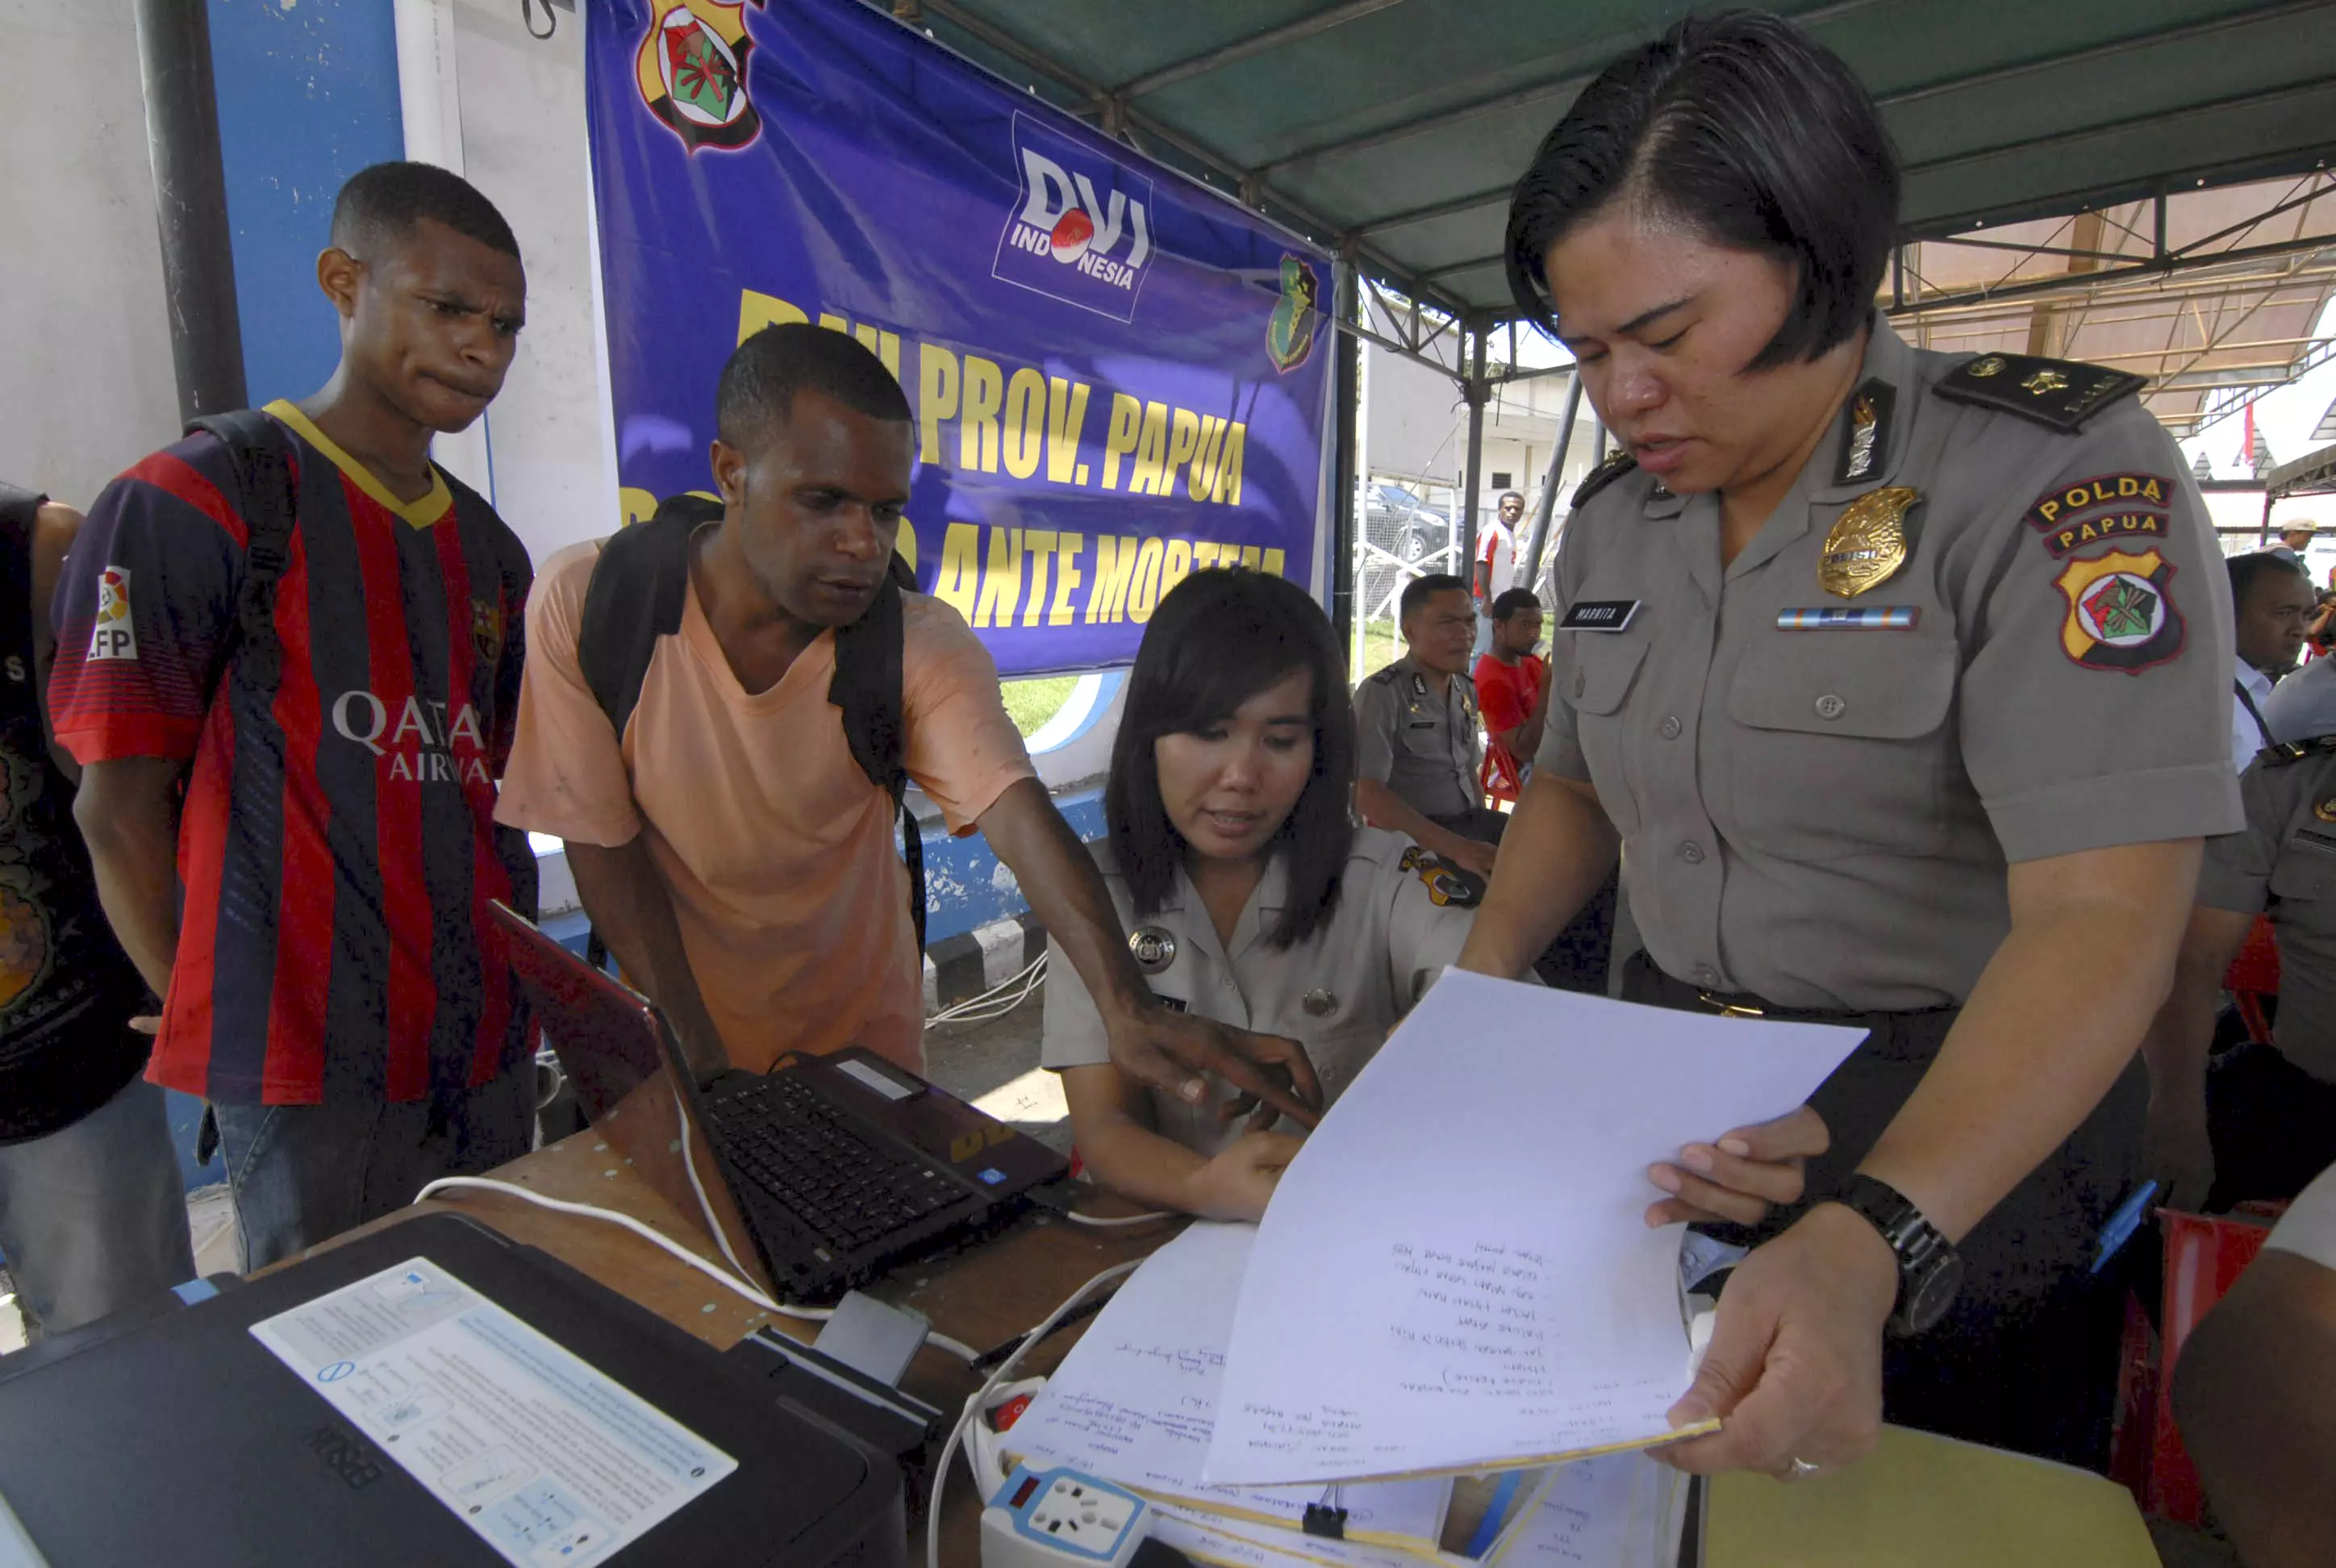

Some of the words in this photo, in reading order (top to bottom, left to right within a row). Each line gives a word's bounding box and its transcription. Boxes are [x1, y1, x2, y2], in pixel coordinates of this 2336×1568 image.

[1020, 147, 1149, 269] DVI
[920, 342, 1089, 486] PROV.
[1102, 392, 1249, 507] PAPUA
[2039, 477, 2161, 521] POLDA
[2059, 515, 2156, 548] PAPUA
[933, 523, 1085, 628] ANTE
[90, 629, 130, 658] FP
[332, 690, 484, 756] QATA
